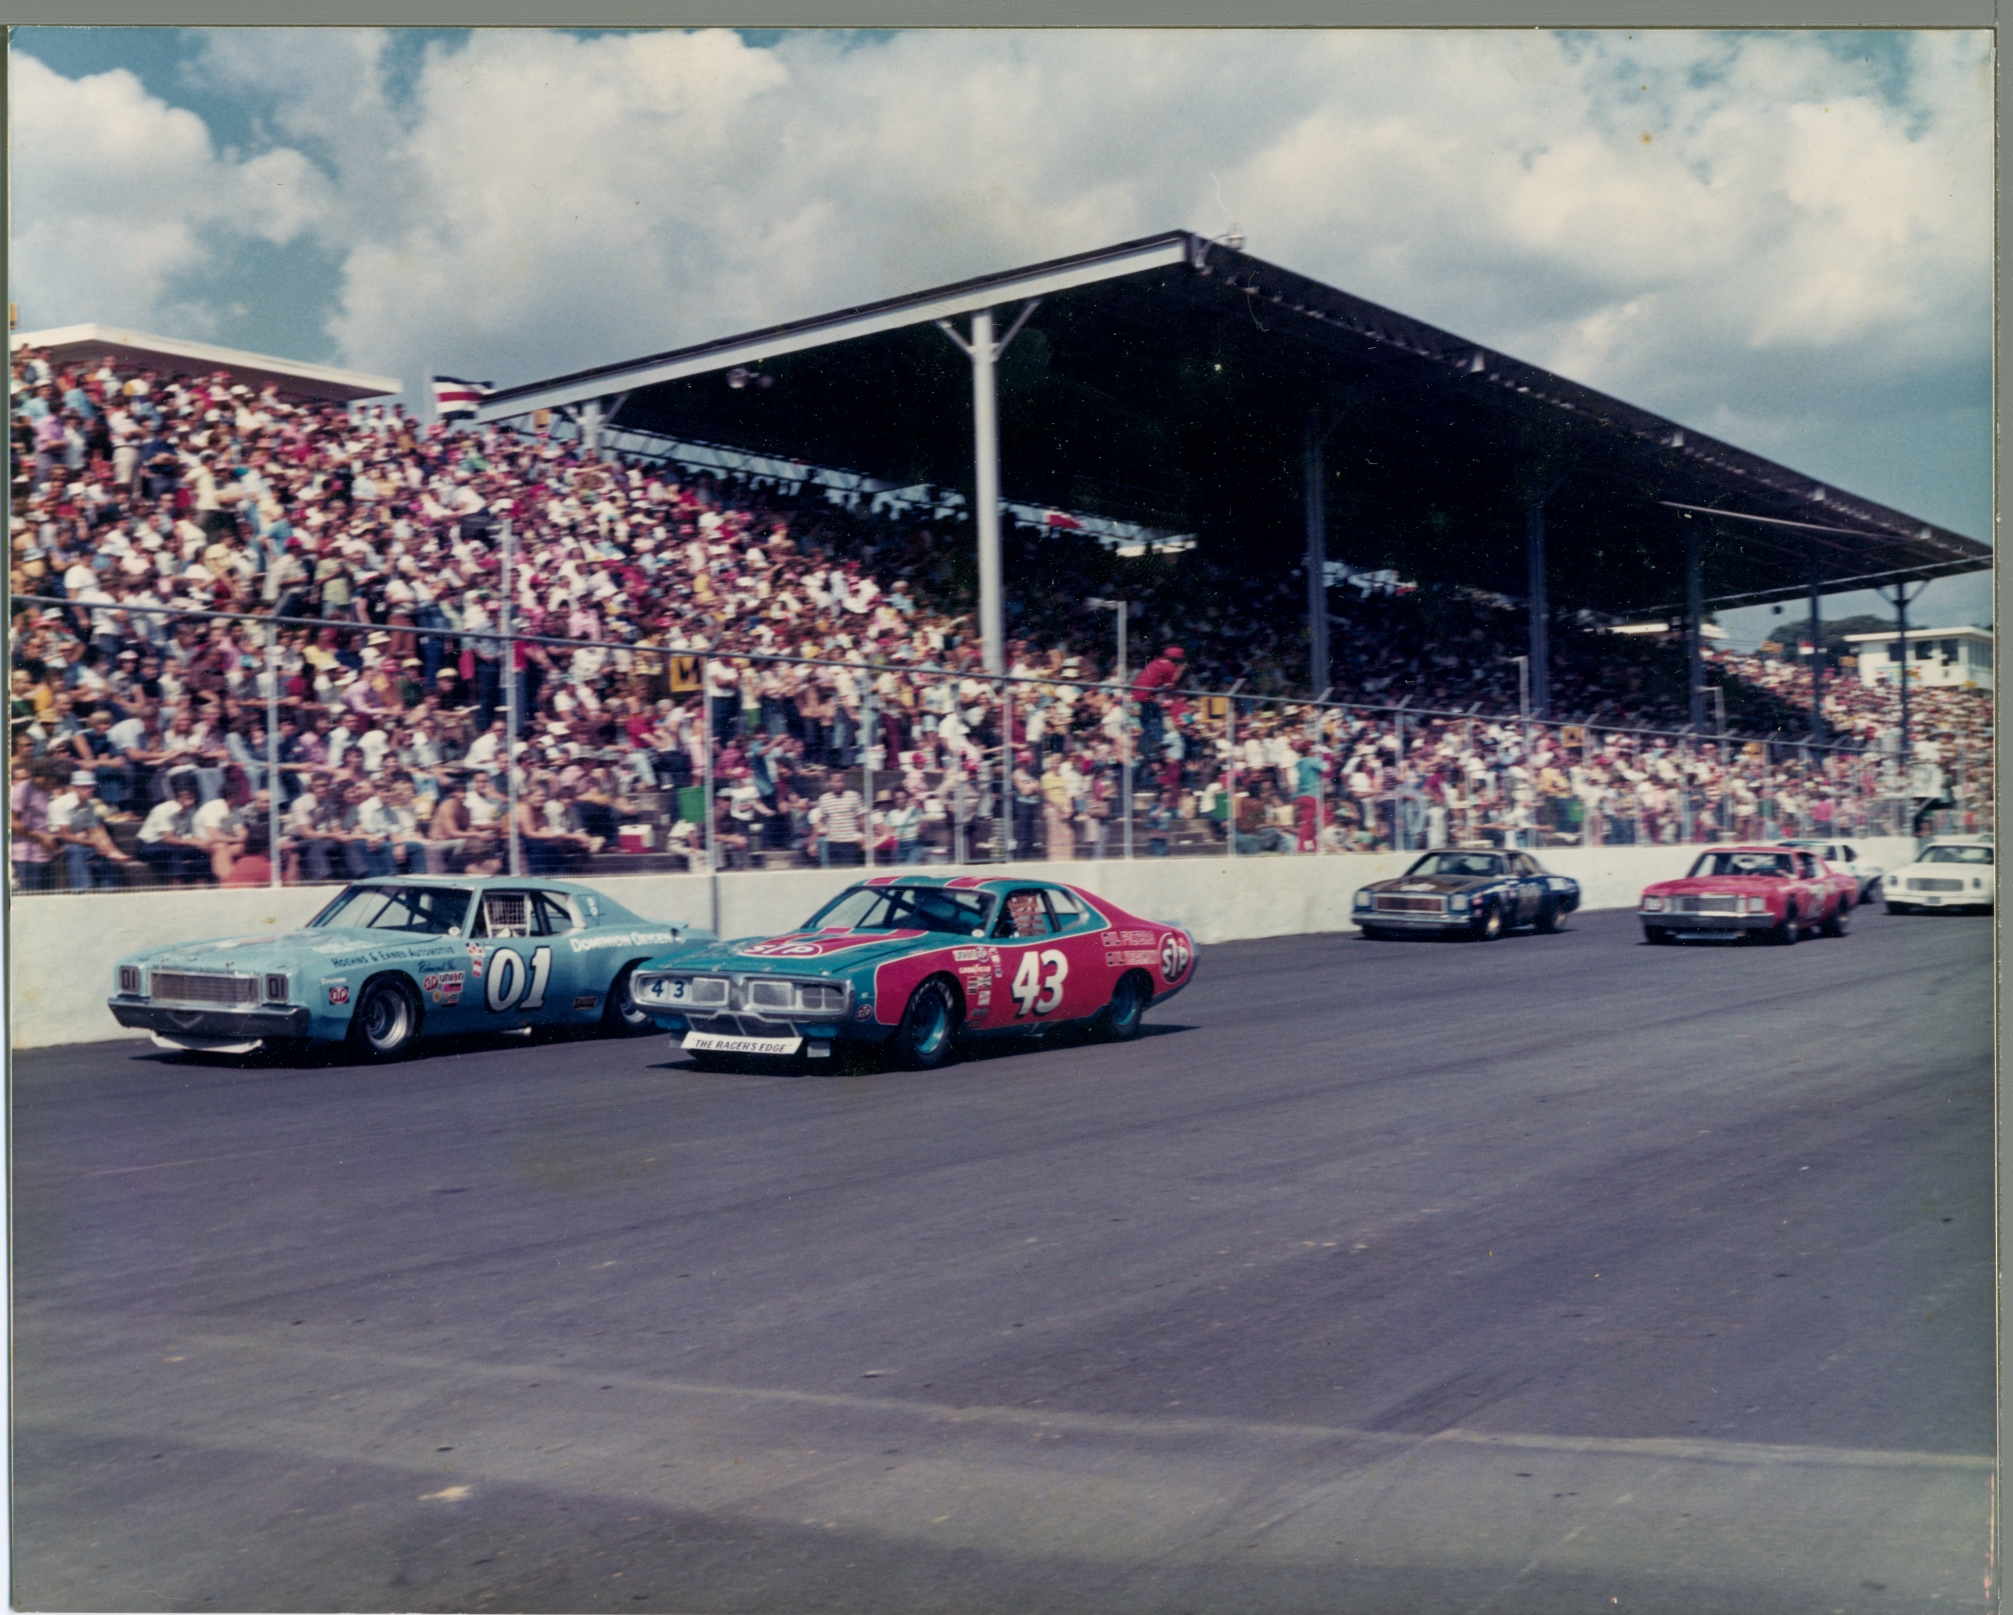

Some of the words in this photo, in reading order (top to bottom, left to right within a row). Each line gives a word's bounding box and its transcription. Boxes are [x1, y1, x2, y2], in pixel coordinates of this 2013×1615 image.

[570, 935, 632, 952] DOMINION
[743, 943, 814, 954] STP
[369, 952, 378, 962] &
[1162, 938, 1188, 977] STP
[122, 969, 136, 989] 01
[268, 977, 285, 998] 01
[425, 976, 438, 989] STP
[486, 947, 551, 1012] 01
[1011, 949, 1068, 1017] 43
[332, 987, 346, 1000] STP
[857, 1005, 872, 1018] STP
